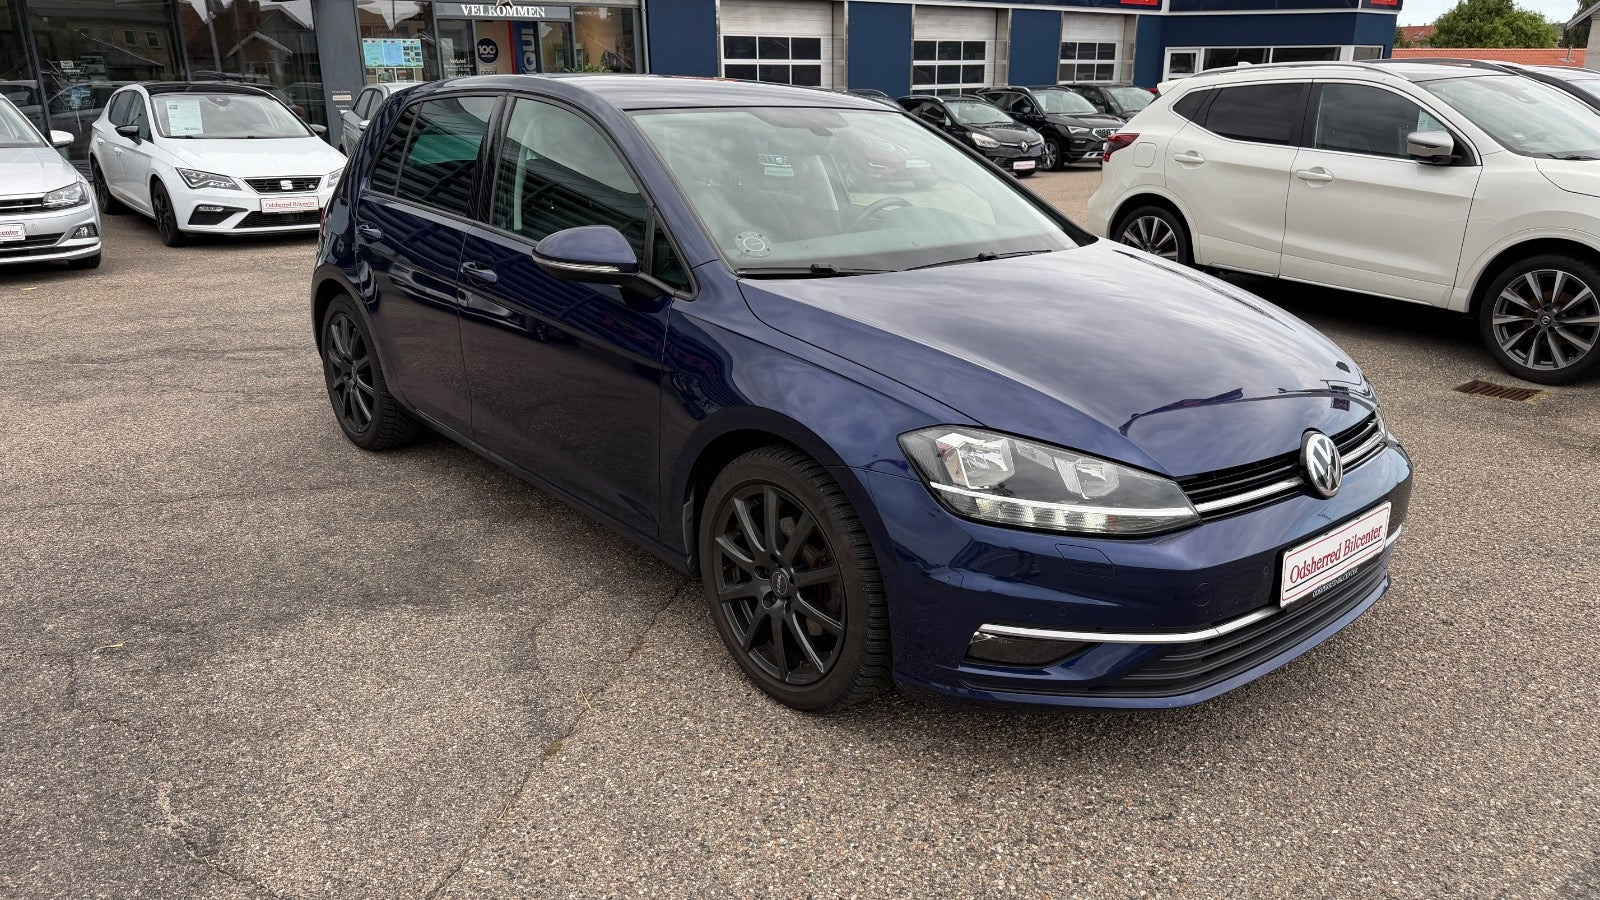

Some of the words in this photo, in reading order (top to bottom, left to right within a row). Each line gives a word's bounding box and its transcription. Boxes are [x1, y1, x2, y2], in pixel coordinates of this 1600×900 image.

[461, 4, 545, 17] VELKOMMEN
[1290, 543, 1342, 584] Odsherred
[1343, 526, 1382, 557] Bilcenter
